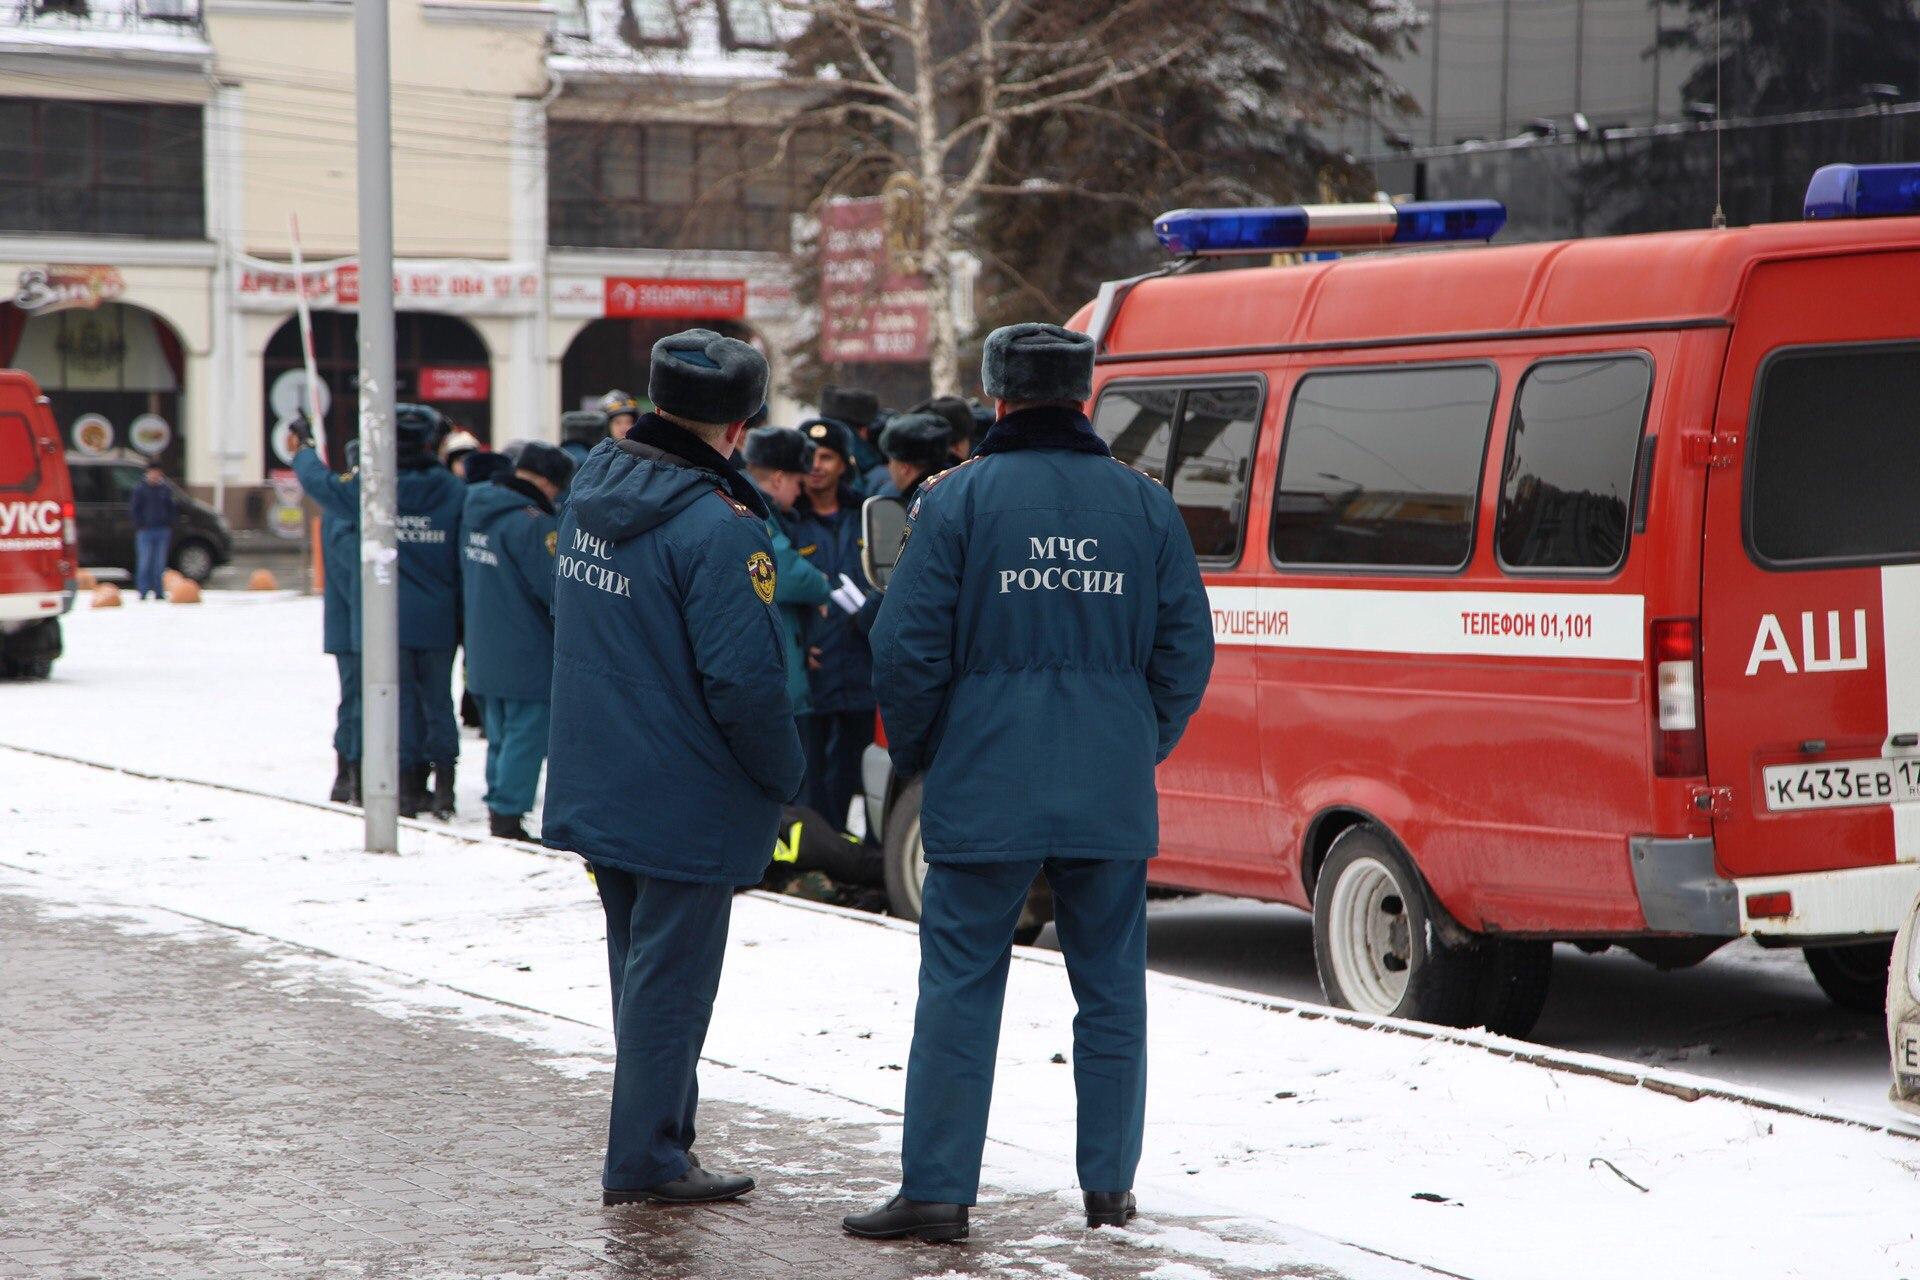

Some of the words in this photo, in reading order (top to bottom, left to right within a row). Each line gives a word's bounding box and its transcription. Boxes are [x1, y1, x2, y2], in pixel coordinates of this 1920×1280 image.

[0, 500, 61, 535] УКС
[571, 528, 615, 560] МЧС
[1028, 536, 1098, 561] МЧС
[558, 554, 631, 598] РОССИИ
[999, 567, 1125, 595] РОССИИ
[1212, 610, 1289, 635] ТУШЕНИЯ
[1461, 612, 1535, 636] ТЕЛЕФОН
[1540, 614, 1592, 642] 01,101
[1745, 609, 1868, 676] АШ
[1776, 767, 1892, 803] К433ЕВ
